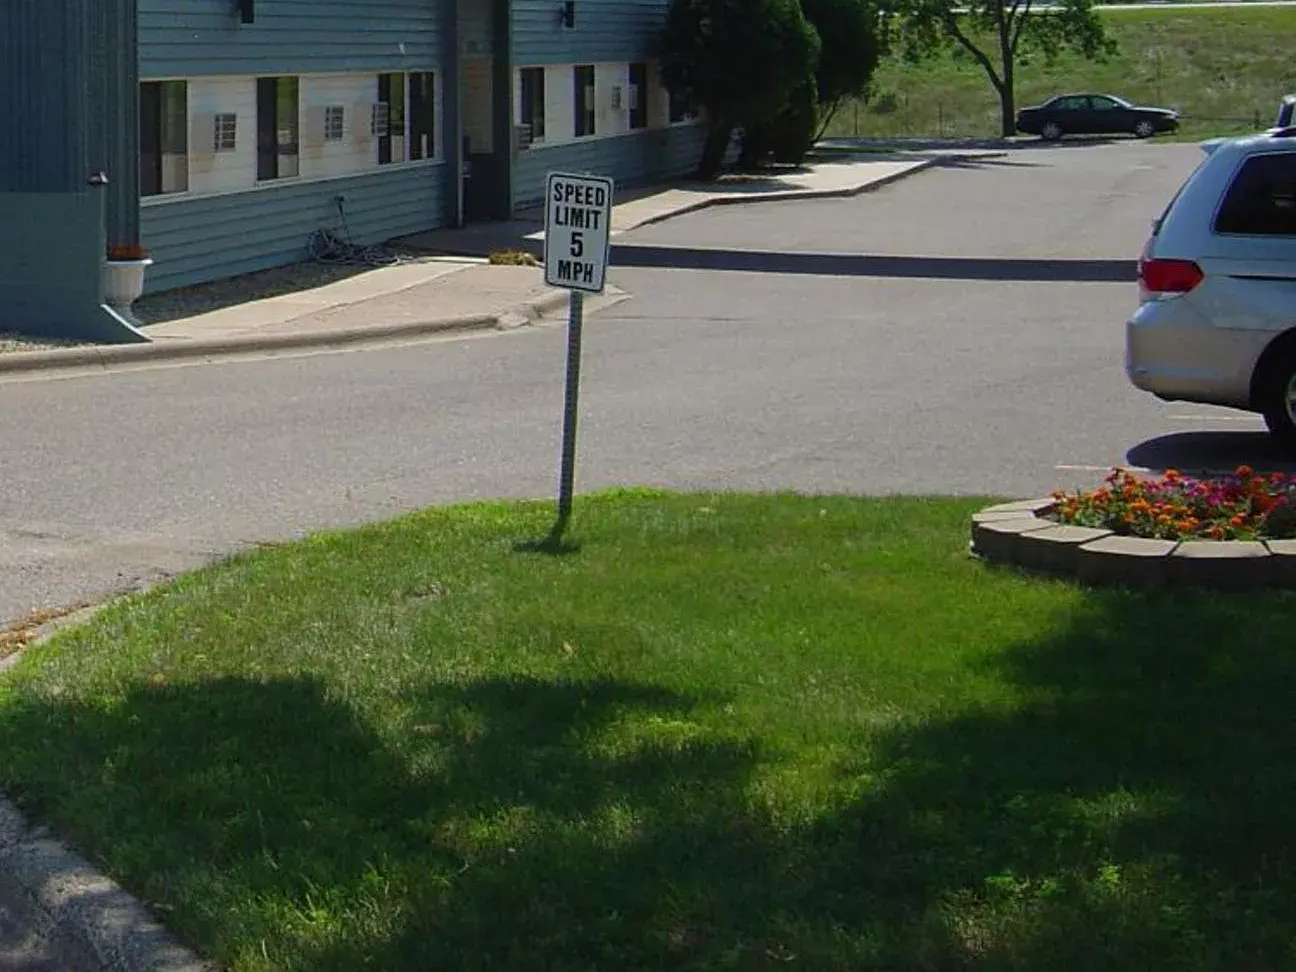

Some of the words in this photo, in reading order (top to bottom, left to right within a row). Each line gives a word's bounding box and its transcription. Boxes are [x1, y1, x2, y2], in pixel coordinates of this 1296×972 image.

[553, 182, 605, 207] SPEED
[555, 206, 602, 230] LIMIT
[570, 231, 583, 258] 5
[557, 259, 593, 283] MPH
